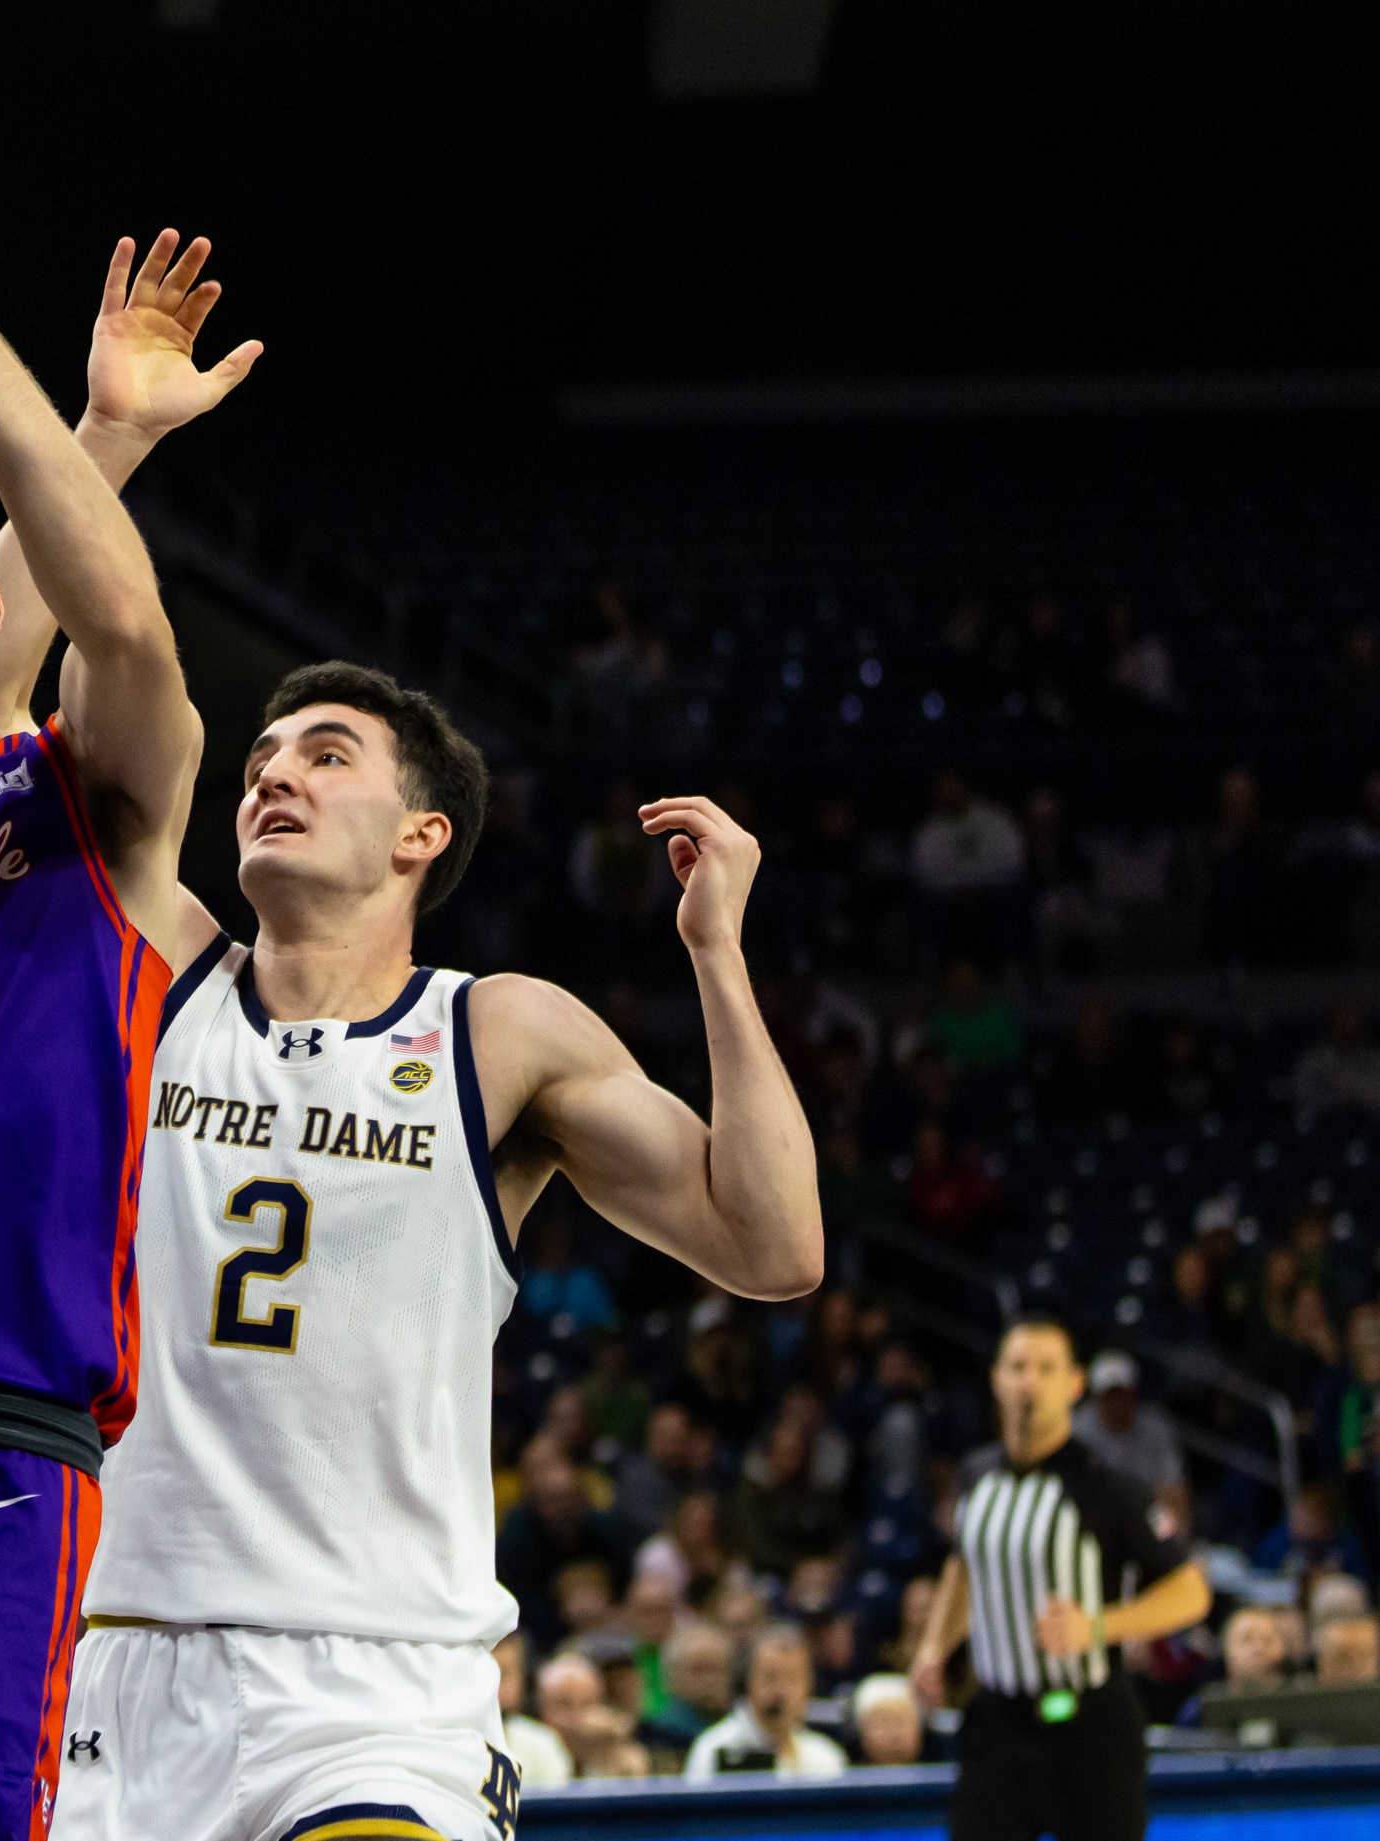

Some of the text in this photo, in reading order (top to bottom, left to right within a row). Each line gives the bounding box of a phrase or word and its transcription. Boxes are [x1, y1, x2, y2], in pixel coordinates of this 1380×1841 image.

[395, 1069, 431, 1079] ACC
[152, 1081, 437, 1171] NOTRE DAME
[208, 1175, 314, 1354] 2
